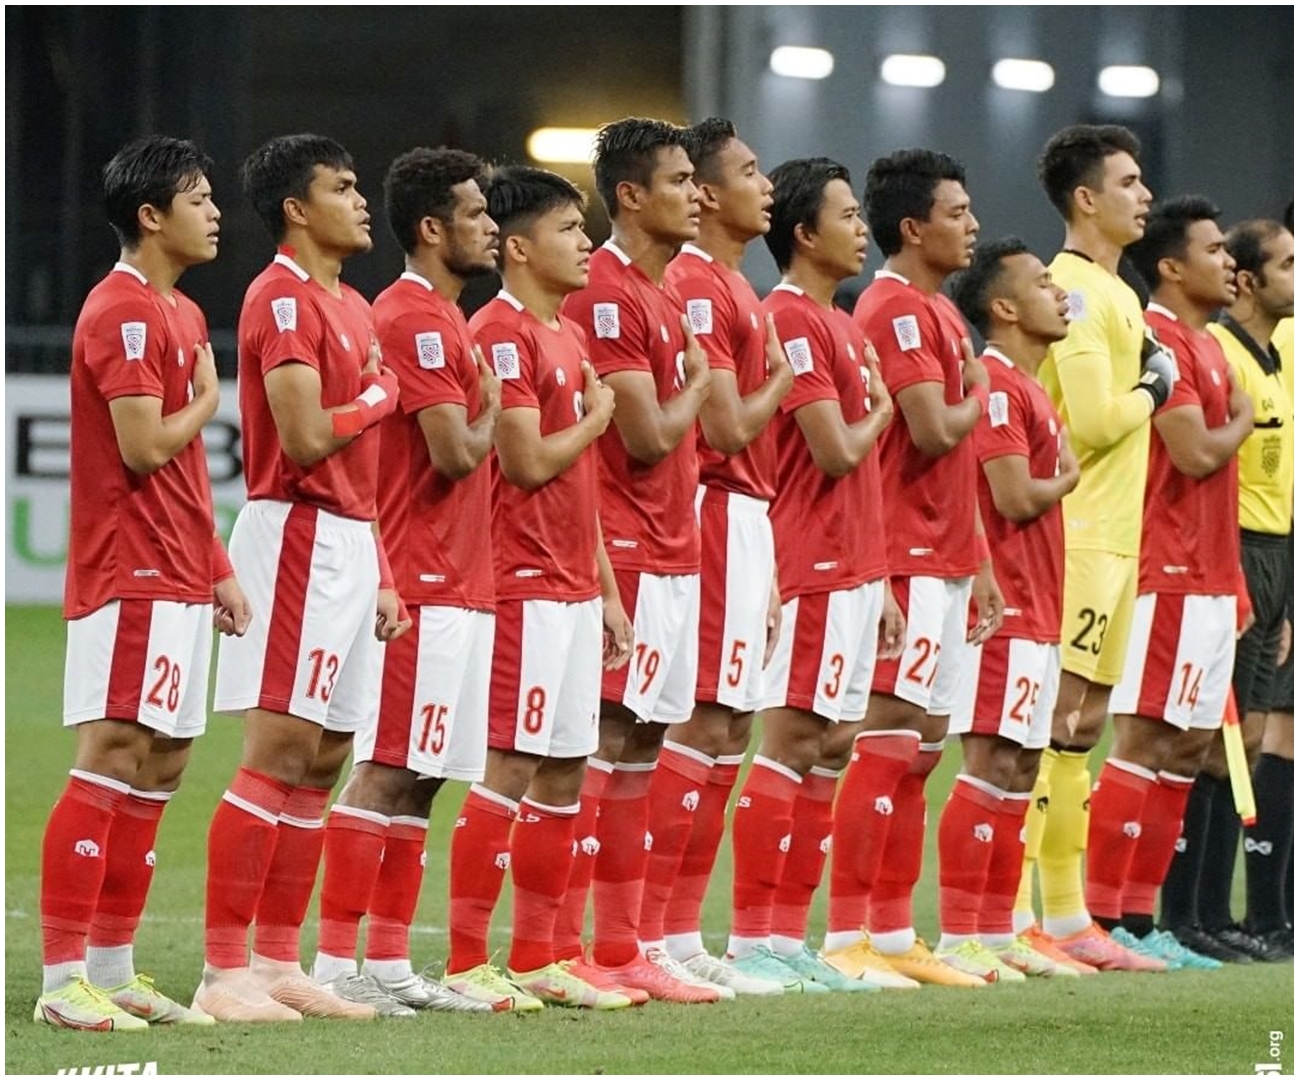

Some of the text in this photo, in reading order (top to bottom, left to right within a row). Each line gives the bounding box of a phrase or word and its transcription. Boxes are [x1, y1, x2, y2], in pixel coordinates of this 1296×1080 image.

[1071, 608, 1108, 655] 23
[146, 655, 181, 712] 28
[306, 648, 339, 702] 13
[636, 643, 660, 695] 19
[727, 639, 746, 688] 5
[825, 653, 844, 698] 3
[417, 702, 448, 754] 15
[523, 686, 545, 734] 8
